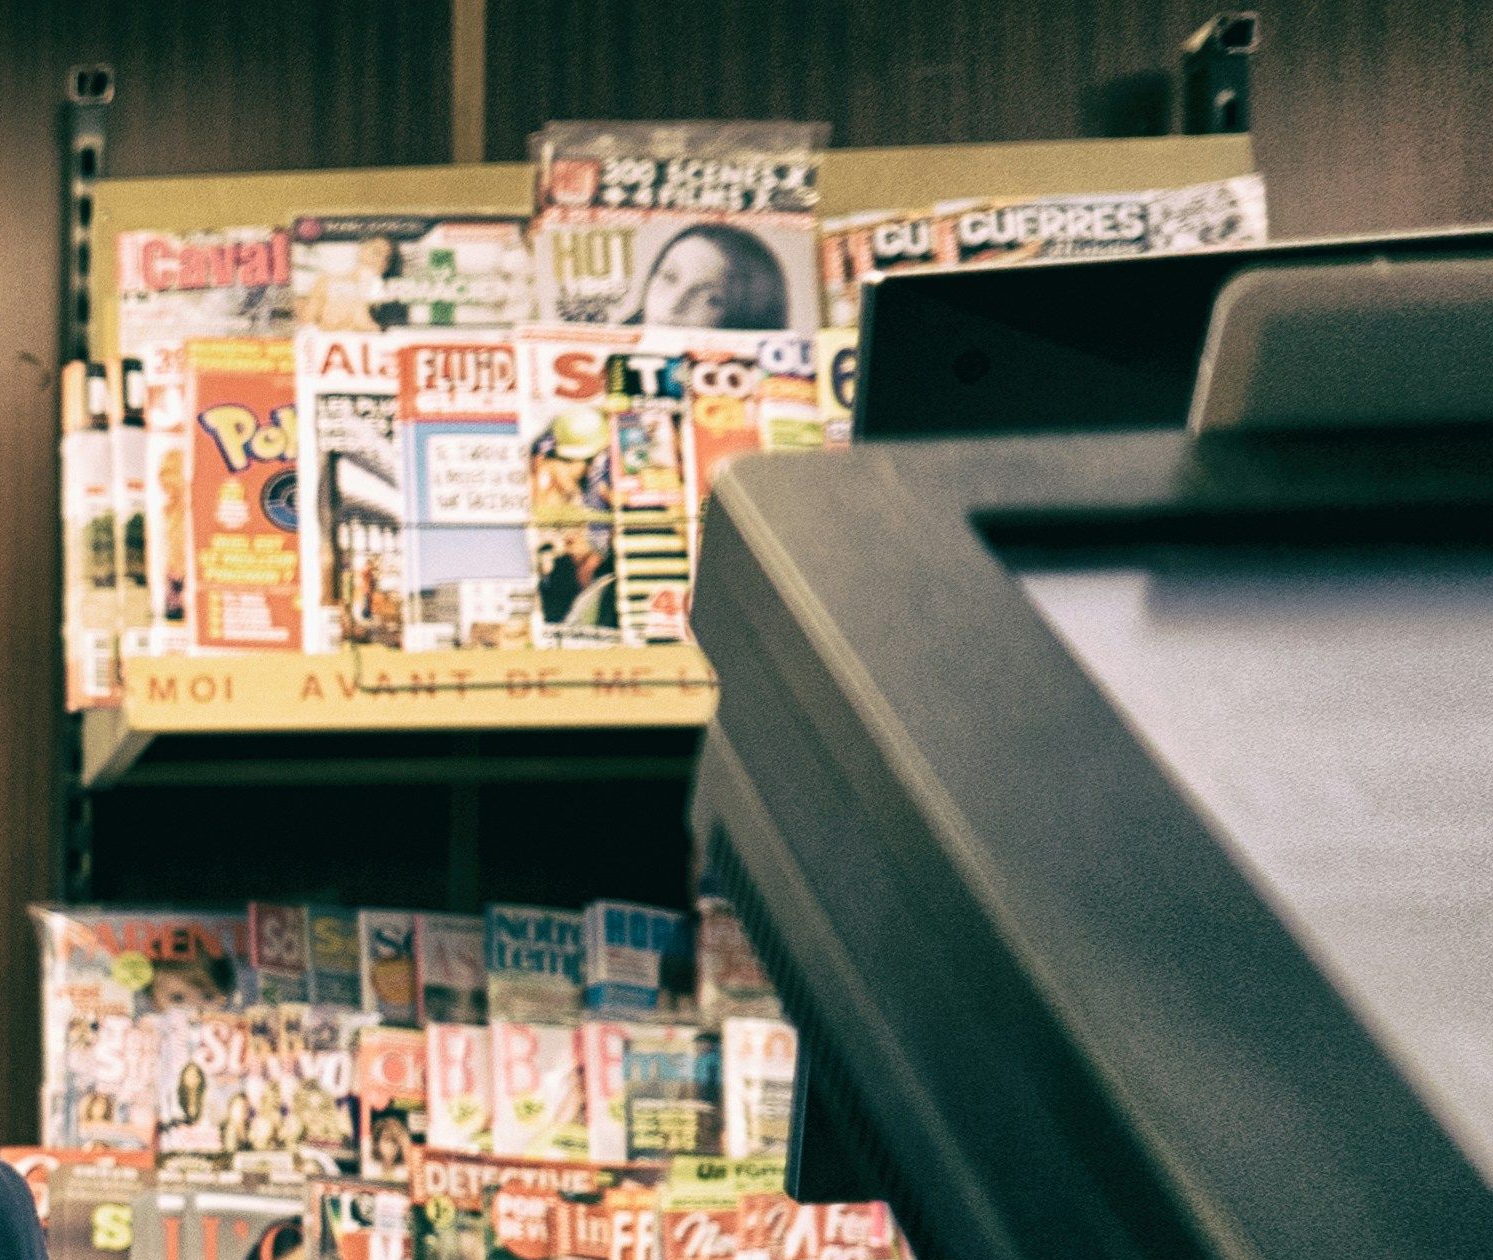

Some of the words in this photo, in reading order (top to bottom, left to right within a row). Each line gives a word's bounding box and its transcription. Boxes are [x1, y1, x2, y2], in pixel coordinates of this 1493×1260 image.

[148, 675, 236, 704] MOI
[300, 672, 474, 703] AVANT
[505, 668, 560, 700] DE
[594, 665, 652, 699] ME
